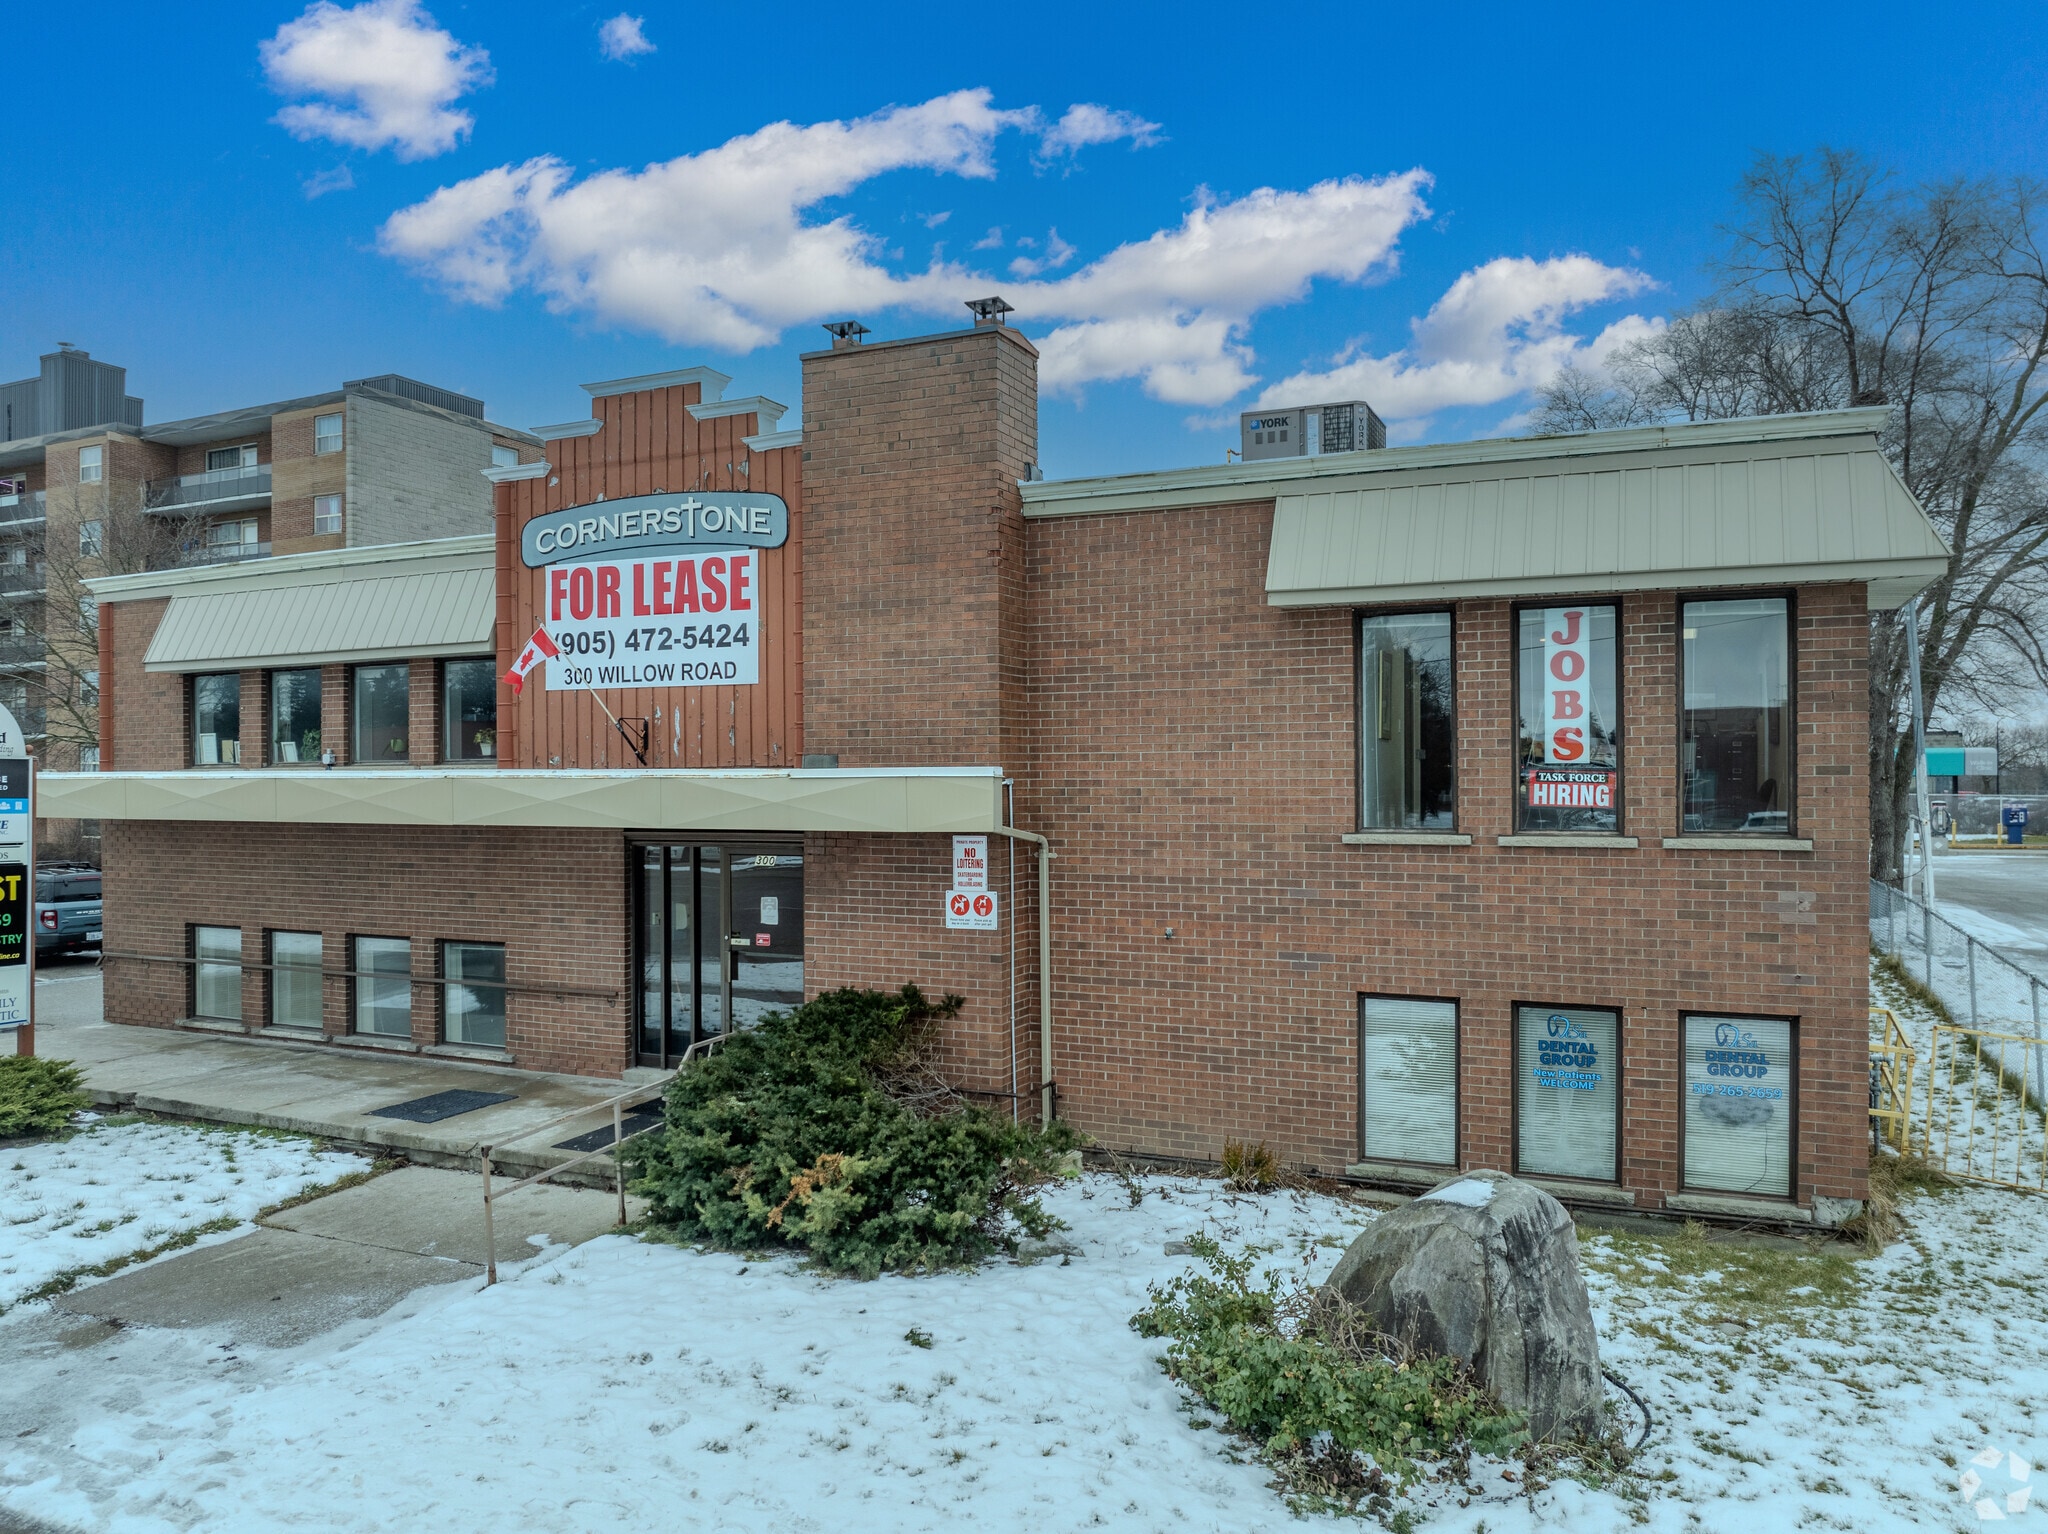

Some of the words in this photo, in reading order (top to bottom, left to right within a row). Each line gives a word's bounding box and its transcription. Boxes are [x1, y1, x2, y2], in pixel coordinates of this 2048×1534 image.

[1260, 417, 1289, 429] YORK
[535, 497, 772, 553] CORNERSTONE
[551, 565, 621, 621] FOR
[633, 555, 751, 617] LEASE
[625, 622, 750, 652] 472-5424
[564, 667, 593, 685] 300
[598, 663, 675, 684] WILLOW
[681, 661, 737, 681] ROAD
[1550, 611, 1585, 761] JOBS
[1538, 772, 1566, 782] TASK
[1569, 773, 1606, 783] FORCE
[1533, 783, 1610, 807] HIRING
[755, 855, 775, 865] 300
[964, 847, 976, 858] NO
[957, 858, 983, 868] LOITERING
[0, 933, 23, 945] TRY
[1538, 1040, 1598, 1055] DENTAL
[1540, 1052, 1597, 1068] GROUP
[1705, 1050, 1770, 1065] DENTAL
[1533, 1068, 1556, 1077] New
[1558, 1070, 1602, 1081] Patients
[1707, 1063, 1768, 1079] GROUP
[1540, 1078, 1595, 1090] WELCOME
[1692, 1083, 1783, 1100] 519-265-2659
